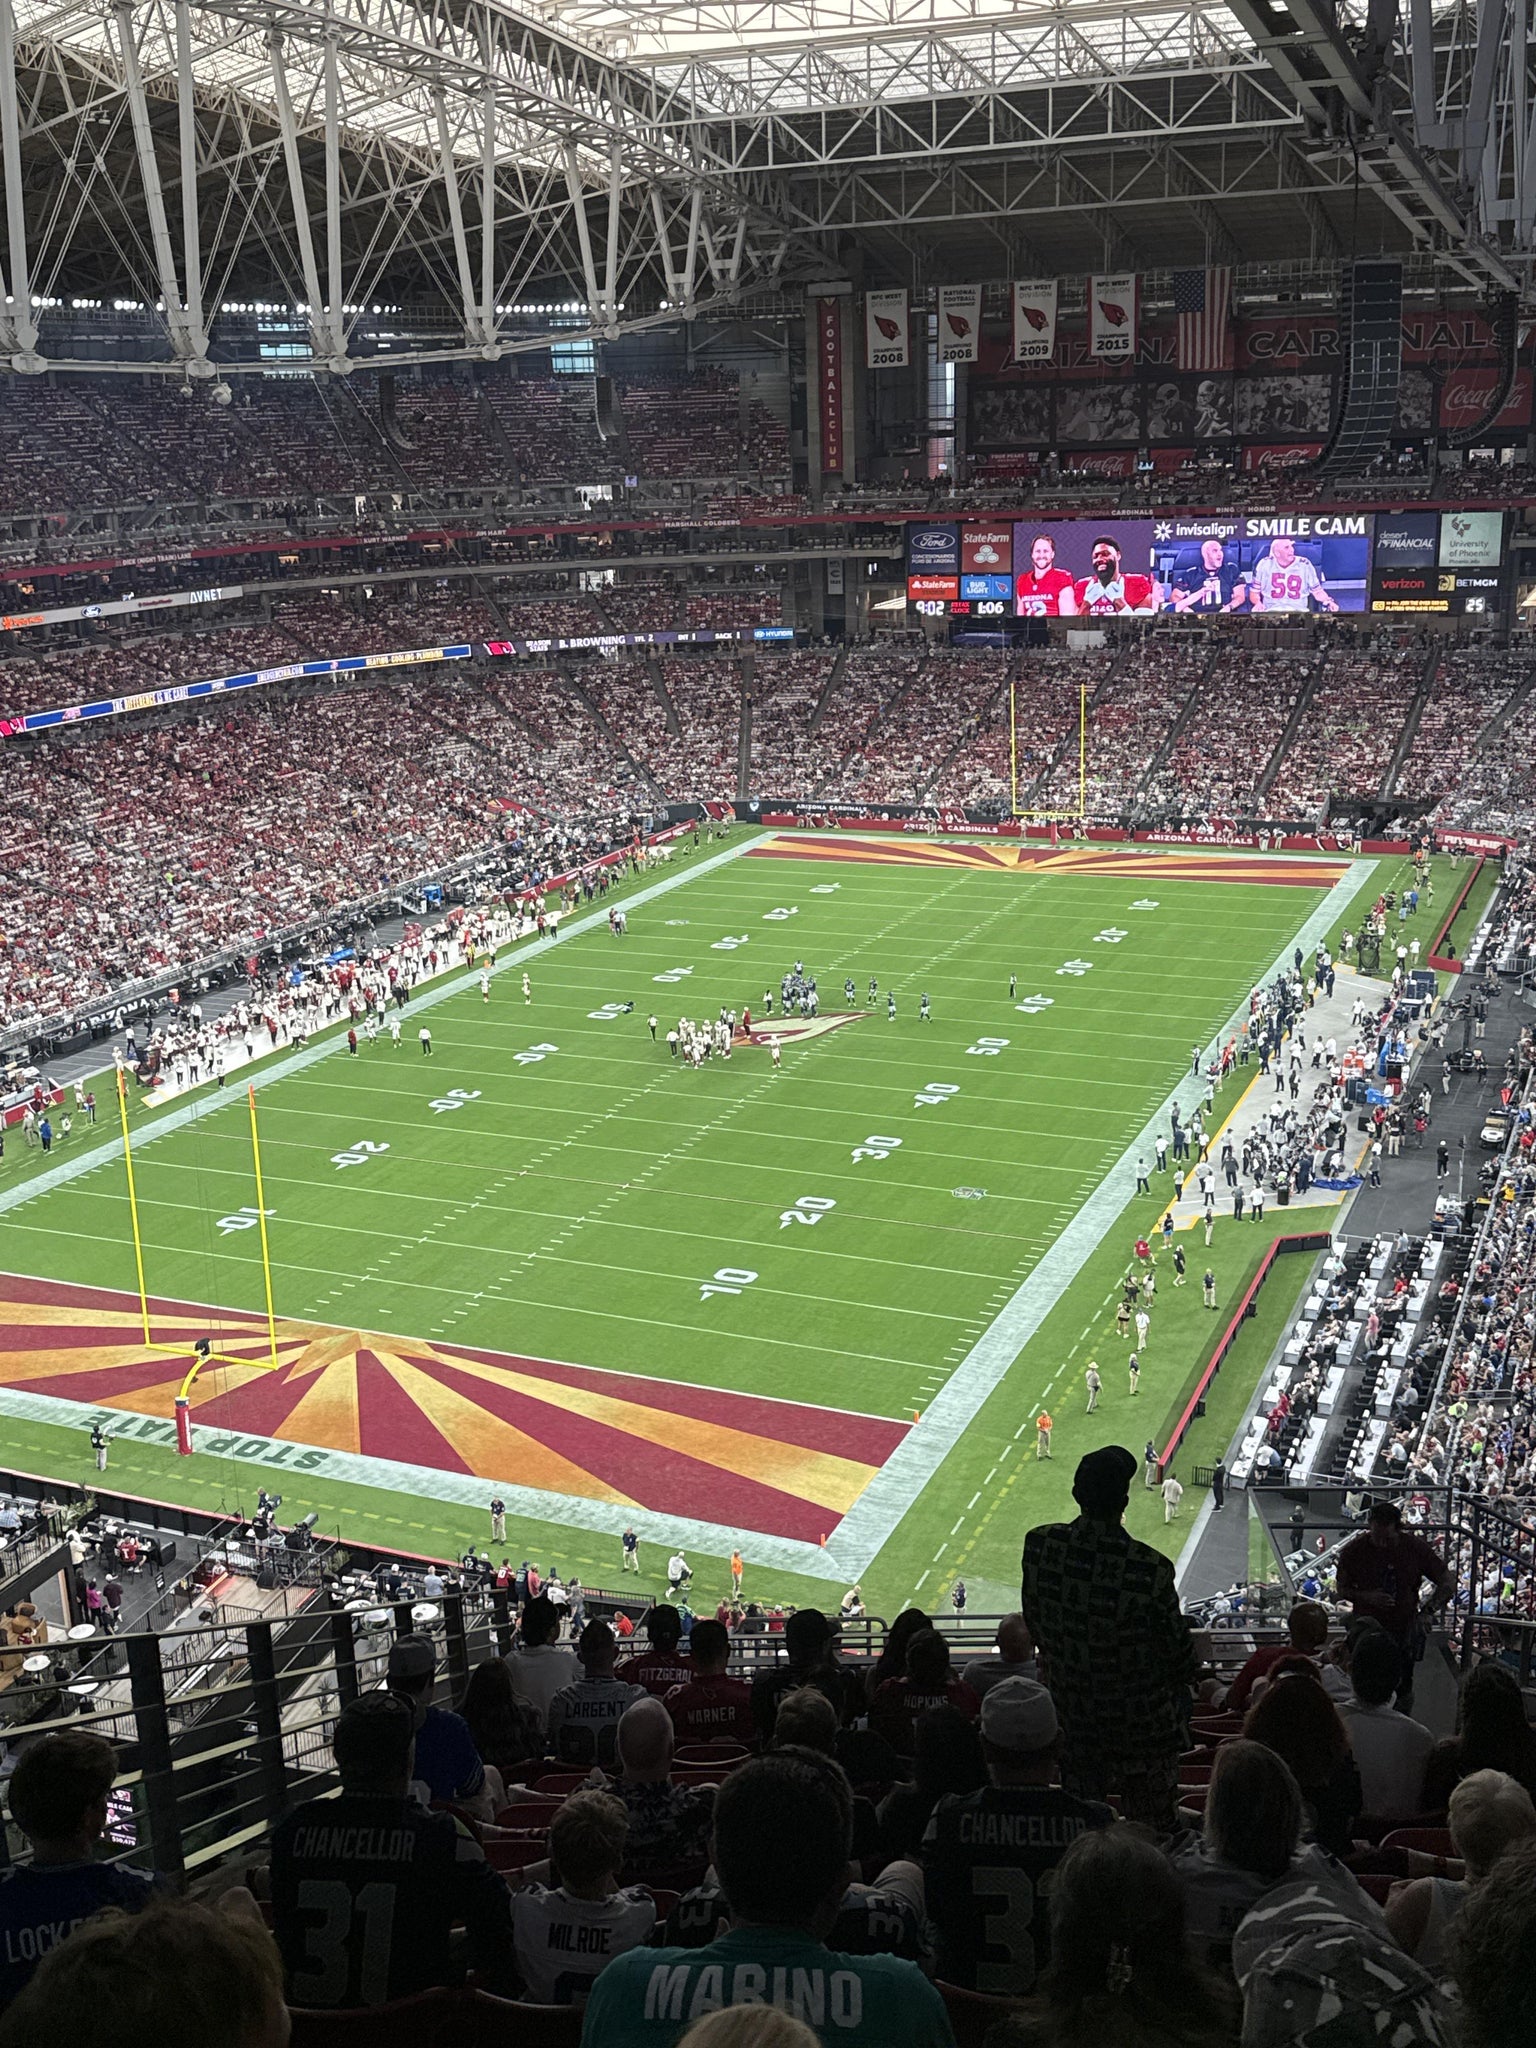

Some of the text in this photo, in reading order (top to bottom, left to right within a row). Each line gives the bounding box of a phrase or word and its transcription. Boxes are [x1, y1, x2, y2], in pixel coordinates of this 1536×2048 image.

[1019, 291, 1052, 299] DIVISION
[1096, 287, 1130, 295] DIVISION
[1020, 346, 1048, 356] 2009
[1096, 339, 1130, 351] 2015
[873, 353, 903, 364] 2008
[942, 348, 972, 360] 2008
[1176, 522, 1235, 539] invisalign
[1246, 517, 1366, 536] SMILE CAM
[920, 534, 946, 547] Ford
[1379, 531, 1409, 539] desert
[1450, 540, 1489, 549] University
[1271, 572, 1302, 600] 59
[1381, 578, 1426, 590] verizon
[1456, 579, 1498, 588] BETMGM
[190, 588, 222, 604] AVNET
[978, 601, 1004, 614] 1:06
[1466, 598, 1483, 611] 25
[559, 640, 568, 649] B.
[570, 636, 626, 648] BROWNING
[648, 634, 654, 642] 2
[947, 825, 998, 834] CARDINALS
[1146, 834, 1192, 842] ARIZONA
[809, 882, 841, 894] 10
[1128, 899, 1160, 910] 10
[762, 906, 799, 920] 20
[710, 934, 749, 950] 30
[1092, 928, 1128, 944] 20
[652, 966, 695, 982] 40
[1055, 960, 1094, 976] 30
[1014, 996, 1055, 1014] 40
[513, 1043, 559, 1063] 40
[965, 1037, 1011, 1056] 50
[428, 1088, 482, 1111] 30
[917, 1082, 960, 1104] 40
[330, 1140, 390, 1166] 20
[851, 1134, 904, 1160] 30
[216, 1206, 278, 1231] 10
[779, 1196, 838, 1226] 20
[698, 1268, 759, 1295] 10
[205, 1438, 330, 1469] STOP
[639, 1668, 692, 1682] FITZGERAL
[566, 1701, 625, 1718] LARGENT
[904, 1695, 949, 1708] HOPKINS
[687, 1706, 736, 1725] WARNER
[293, 1827, 416, 1863] CHANCELLOR
[293, 1880, 397, 2007] 31
[548, 1922, 612, 1955] MILROE
[644, 1964, 863, 2029] MARINO
